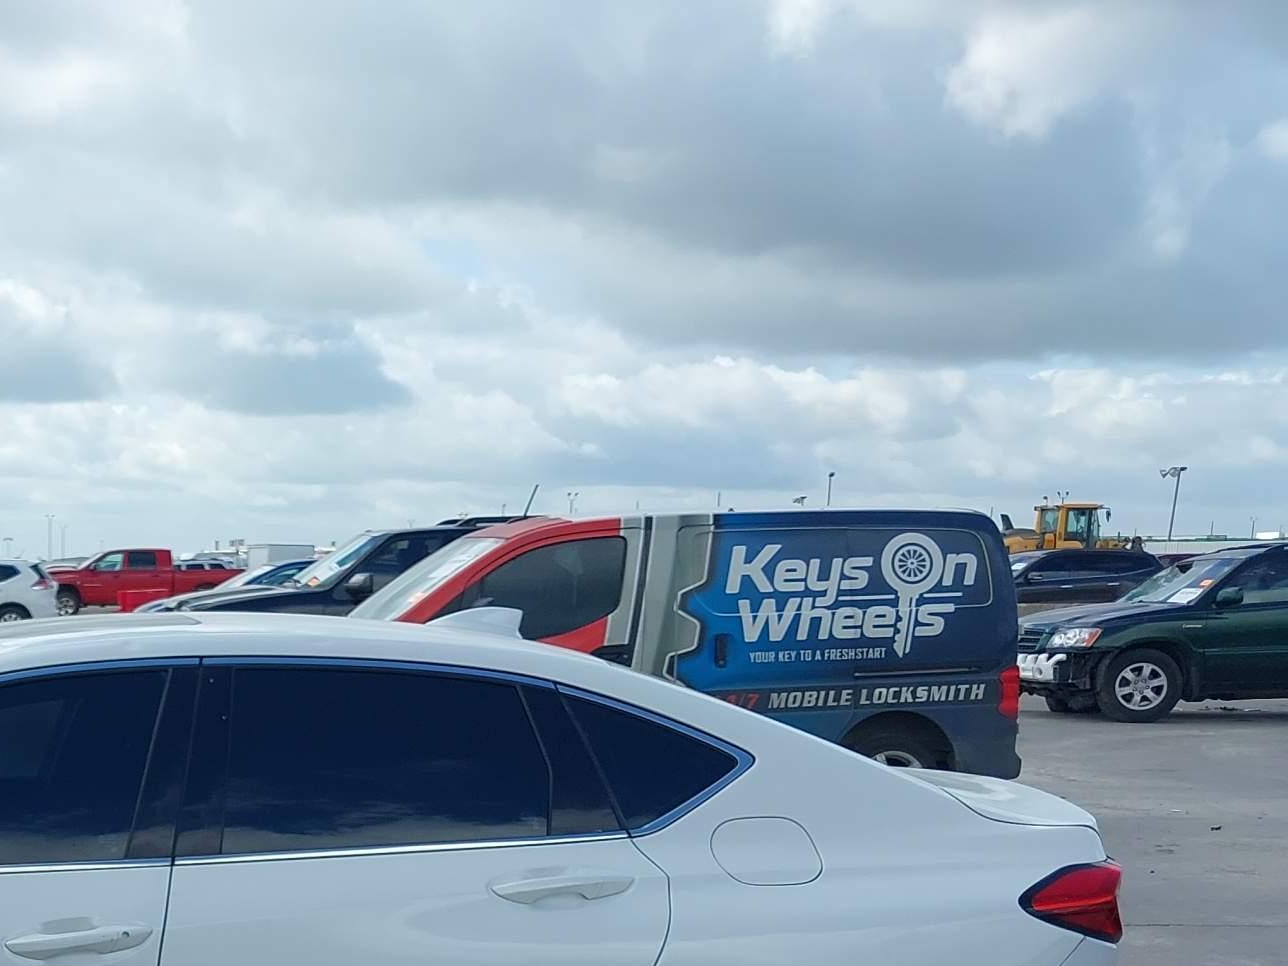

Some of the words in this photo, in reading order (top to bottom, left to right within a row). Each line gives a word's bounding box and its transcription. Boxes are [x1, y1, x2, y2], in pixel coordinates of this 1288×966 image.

[725, 544, 873, 607] Keys
[881, 532, 978, 592] On
[738, 597, 955, 657] Wheels
[749, 651, 776, 663] YOUR
[778, 650, 799, 662] KEY
[800, 650, 812, 661] TO
[814, 650, 822, 661] A
[768, 689, 853, 709] MOBILE
[859, 683, 986, 705] LOCKSMITH
